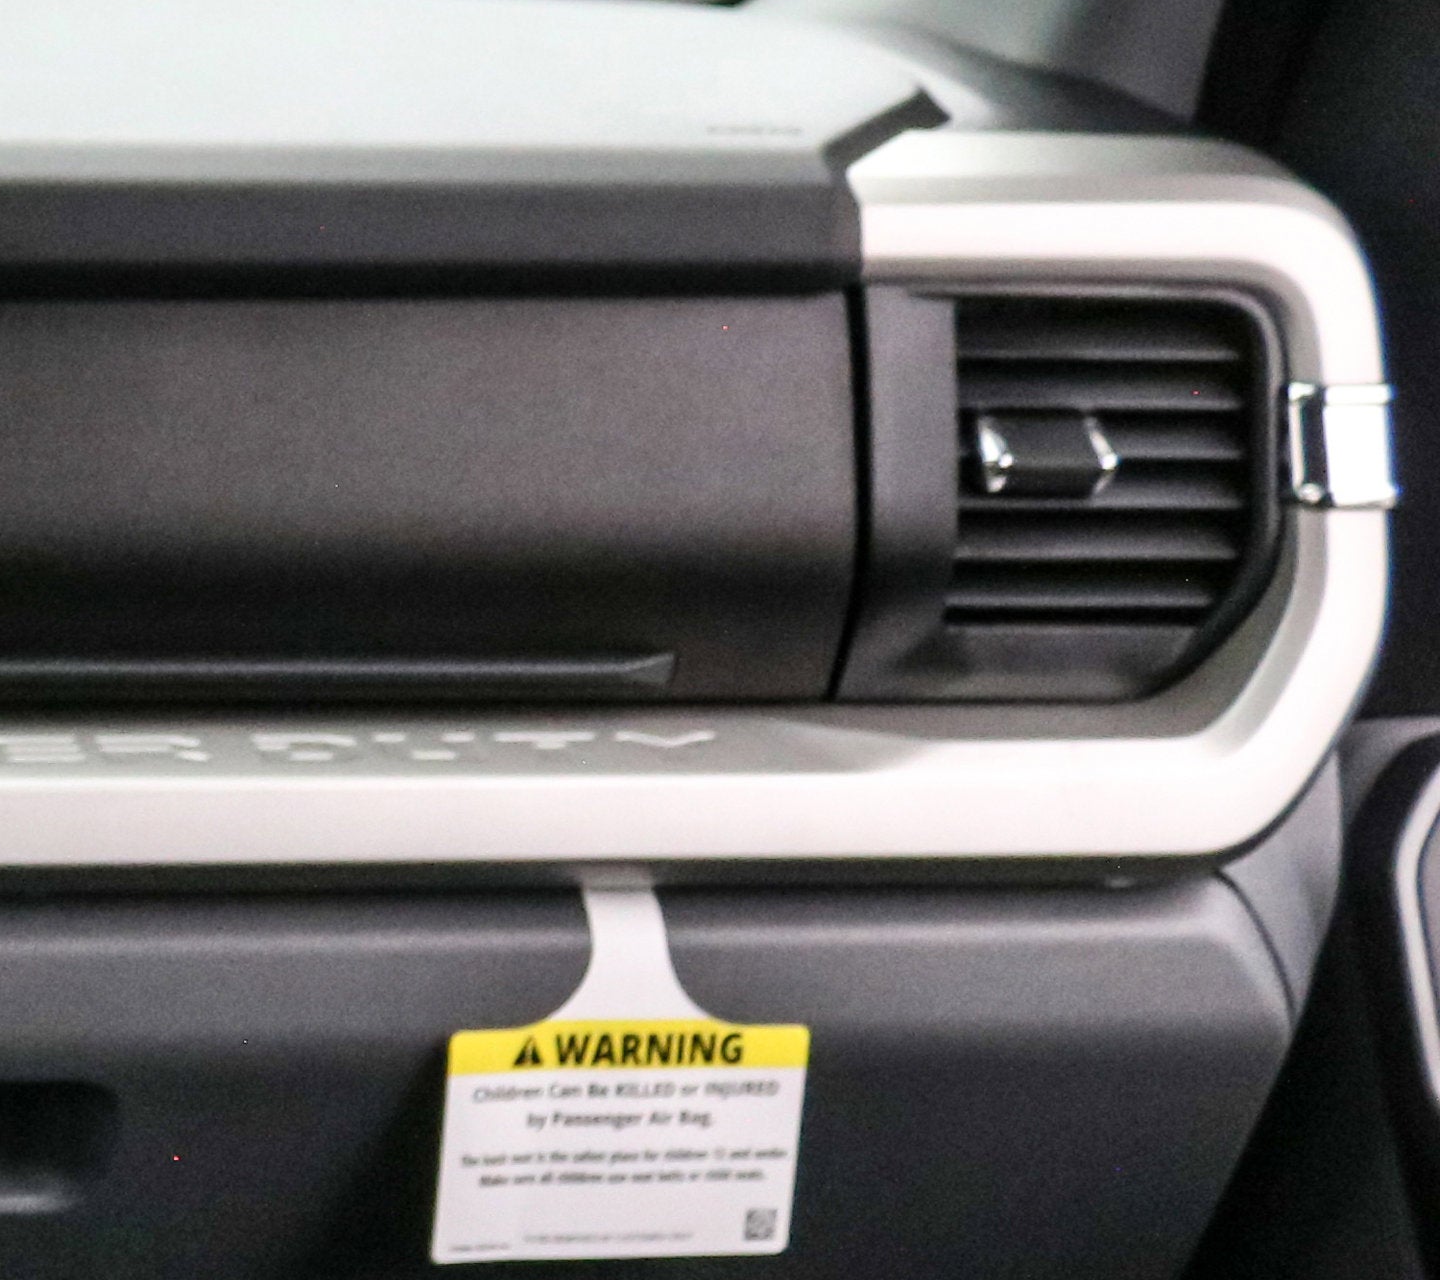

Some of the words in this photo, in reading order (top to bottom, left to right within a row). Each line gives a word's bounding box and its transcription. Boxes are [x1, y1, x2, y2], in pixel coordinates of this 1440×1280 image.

[554, 1031, 745, 1066] WARNING
[472, 1085, 543, 1102] Children
[549, 1084, 583, 1099] Can
